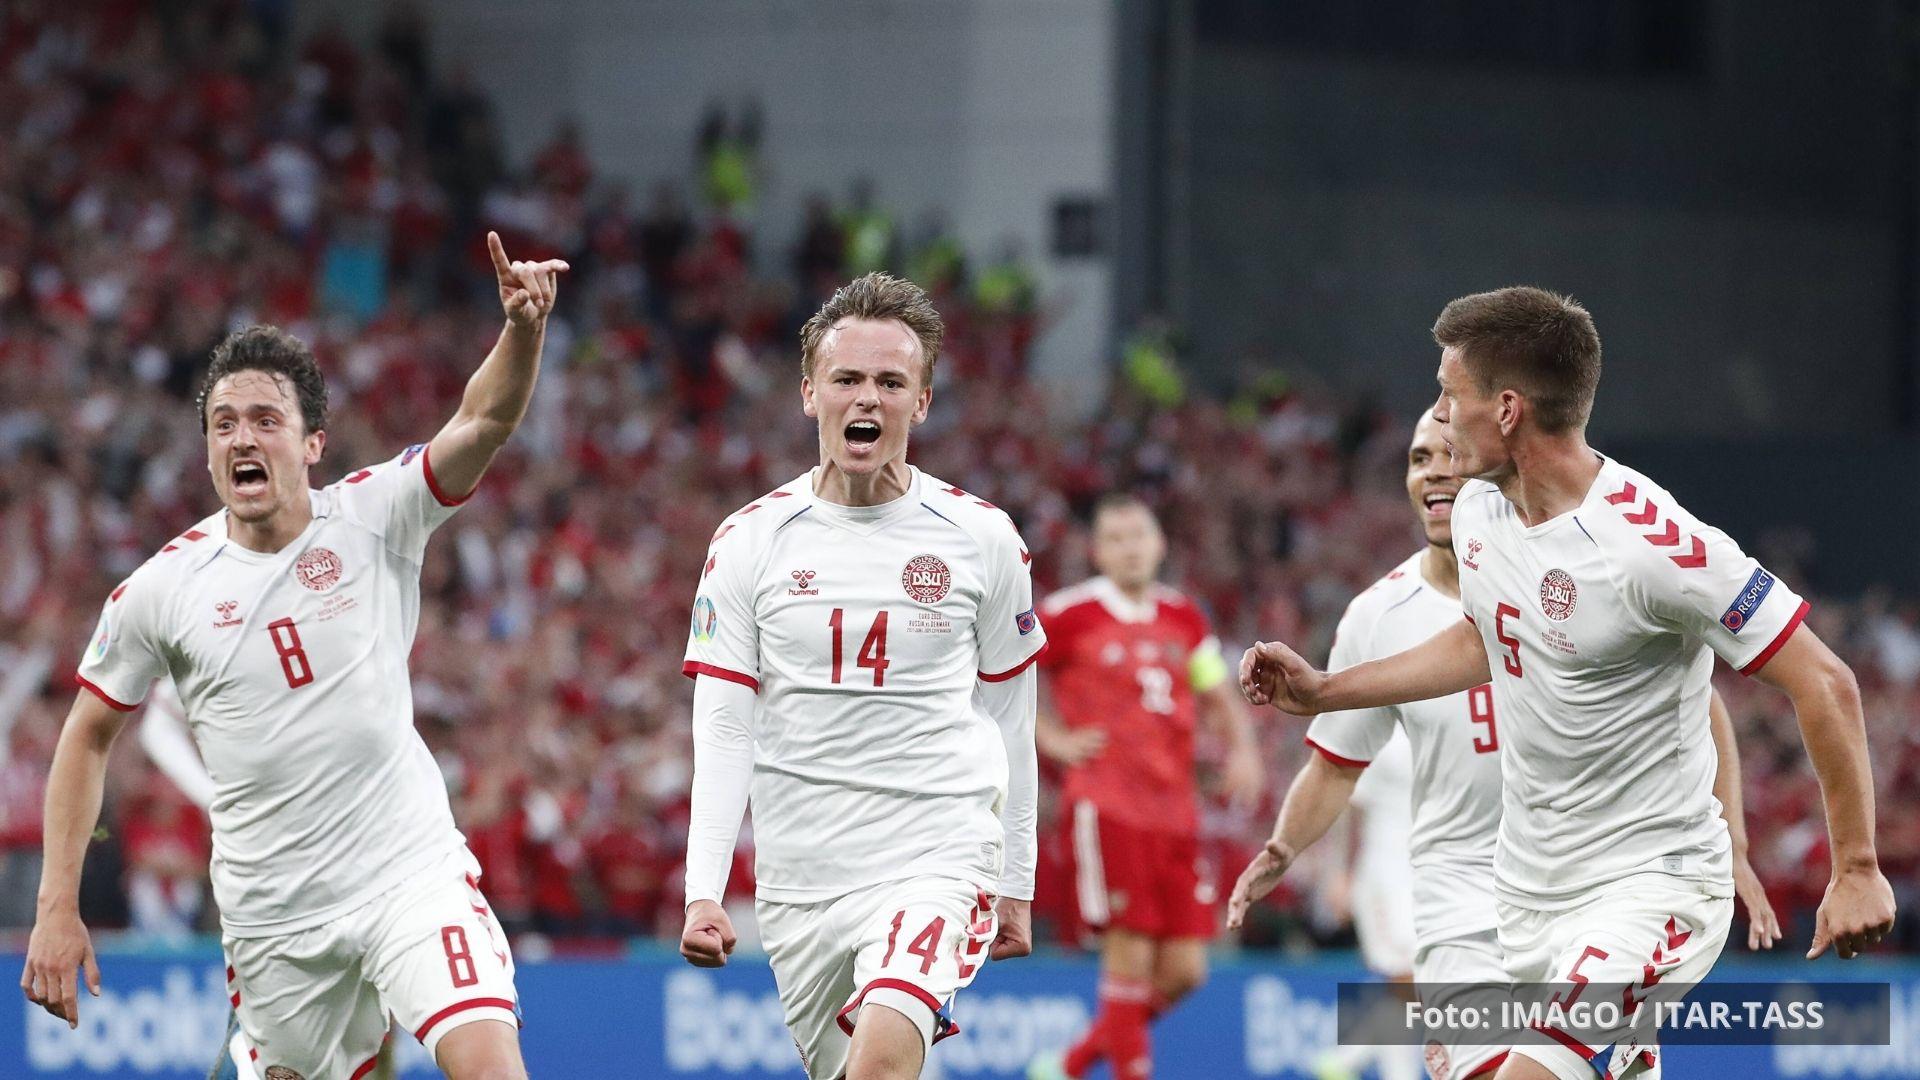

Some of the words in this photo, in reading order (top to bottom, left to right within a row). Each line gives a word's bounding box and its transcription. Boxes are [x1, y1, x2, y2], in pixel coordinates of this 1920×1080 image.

[303, 558, 335, 581] DBU
[788, 588, 819, 596] hummel
[911, 571, 942, 587] DBU
[1547, 584, 1571, 605] DBU
[1737, 571, 1770, 615] RESPECT
[267, 617, 315, 690] 8
[828, 608, 891, 688] 14
[1496, 601, 1523, 679] 5
[1469, 682, 1499, 754] 9
[440, 925, 479, 989] 8
[881, 909, 947, 976] 14
[1548, 945, 1610, 1013] 5
